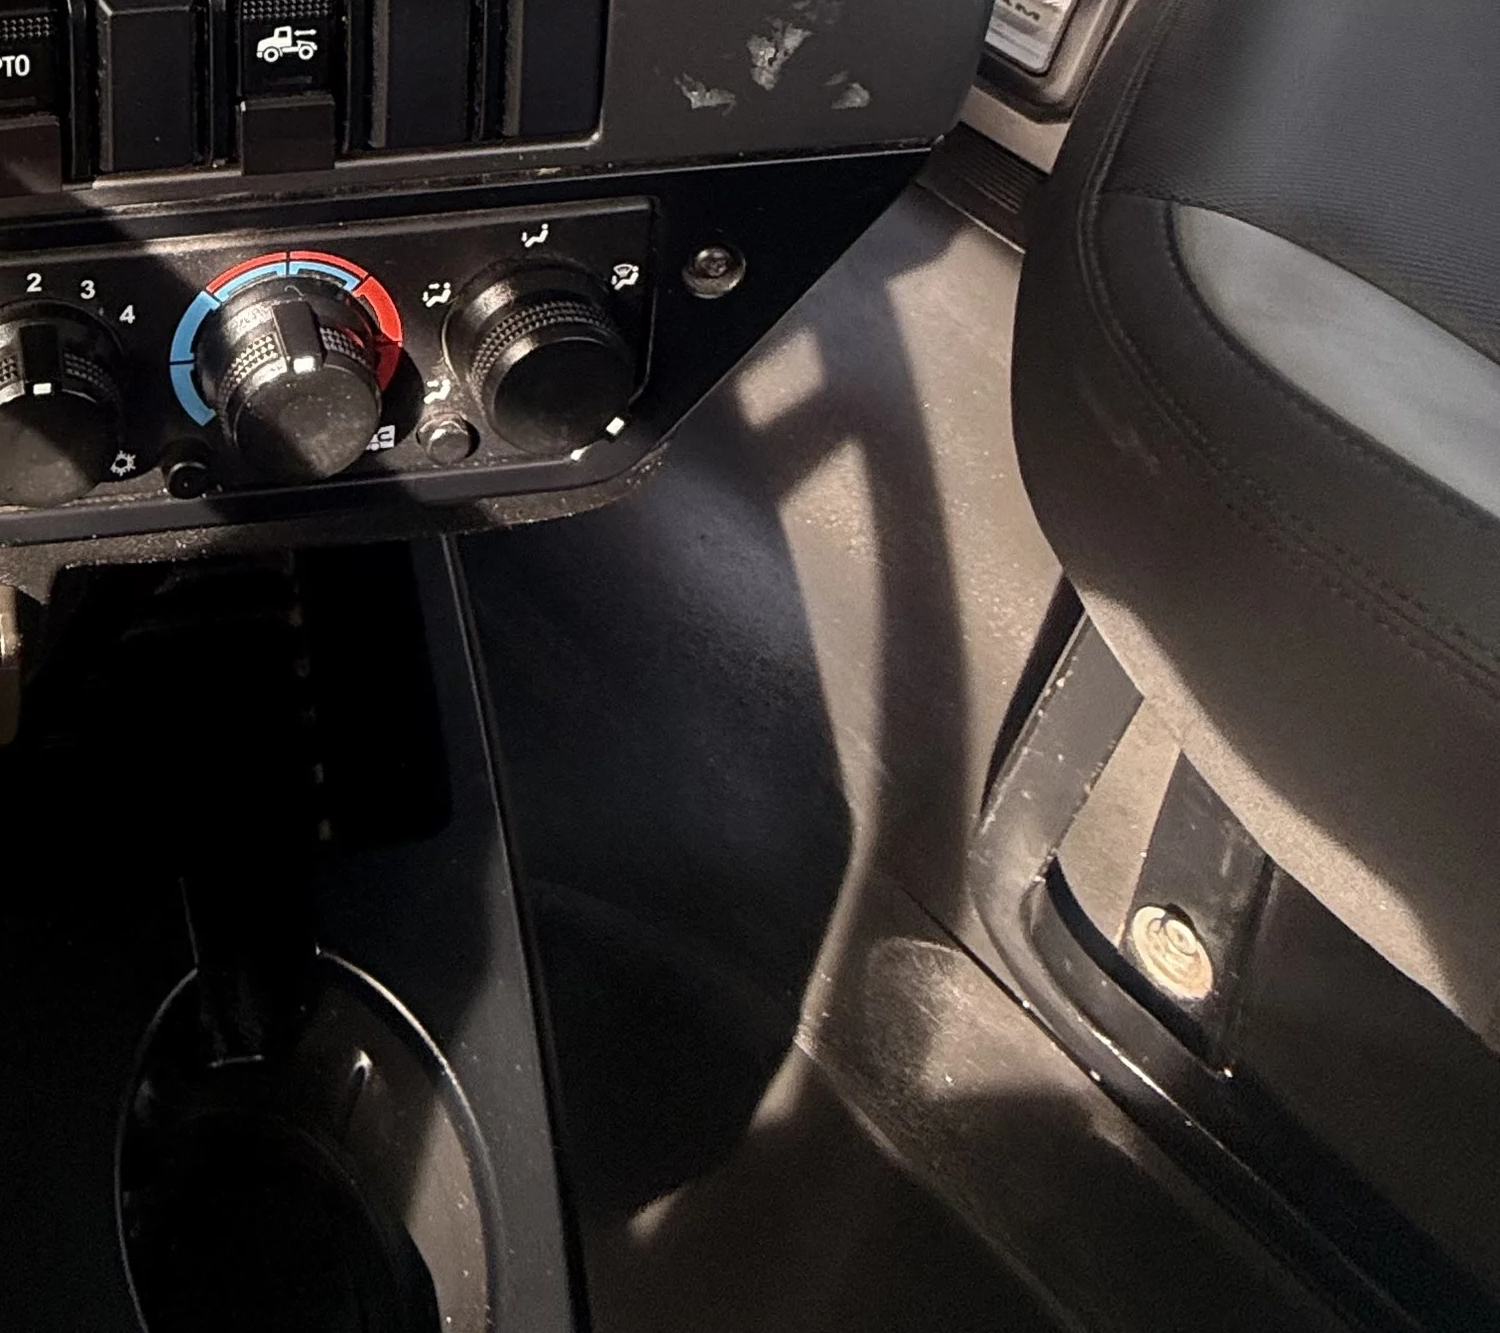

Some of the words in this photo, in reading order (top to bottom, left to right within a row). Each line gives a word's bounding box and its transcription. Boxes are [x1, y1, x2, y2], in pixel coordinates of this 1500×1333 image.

[26, 273, 43, 293] 2
[80, 279, 97, 300] 3
[119, 304, 136, 325] 4
